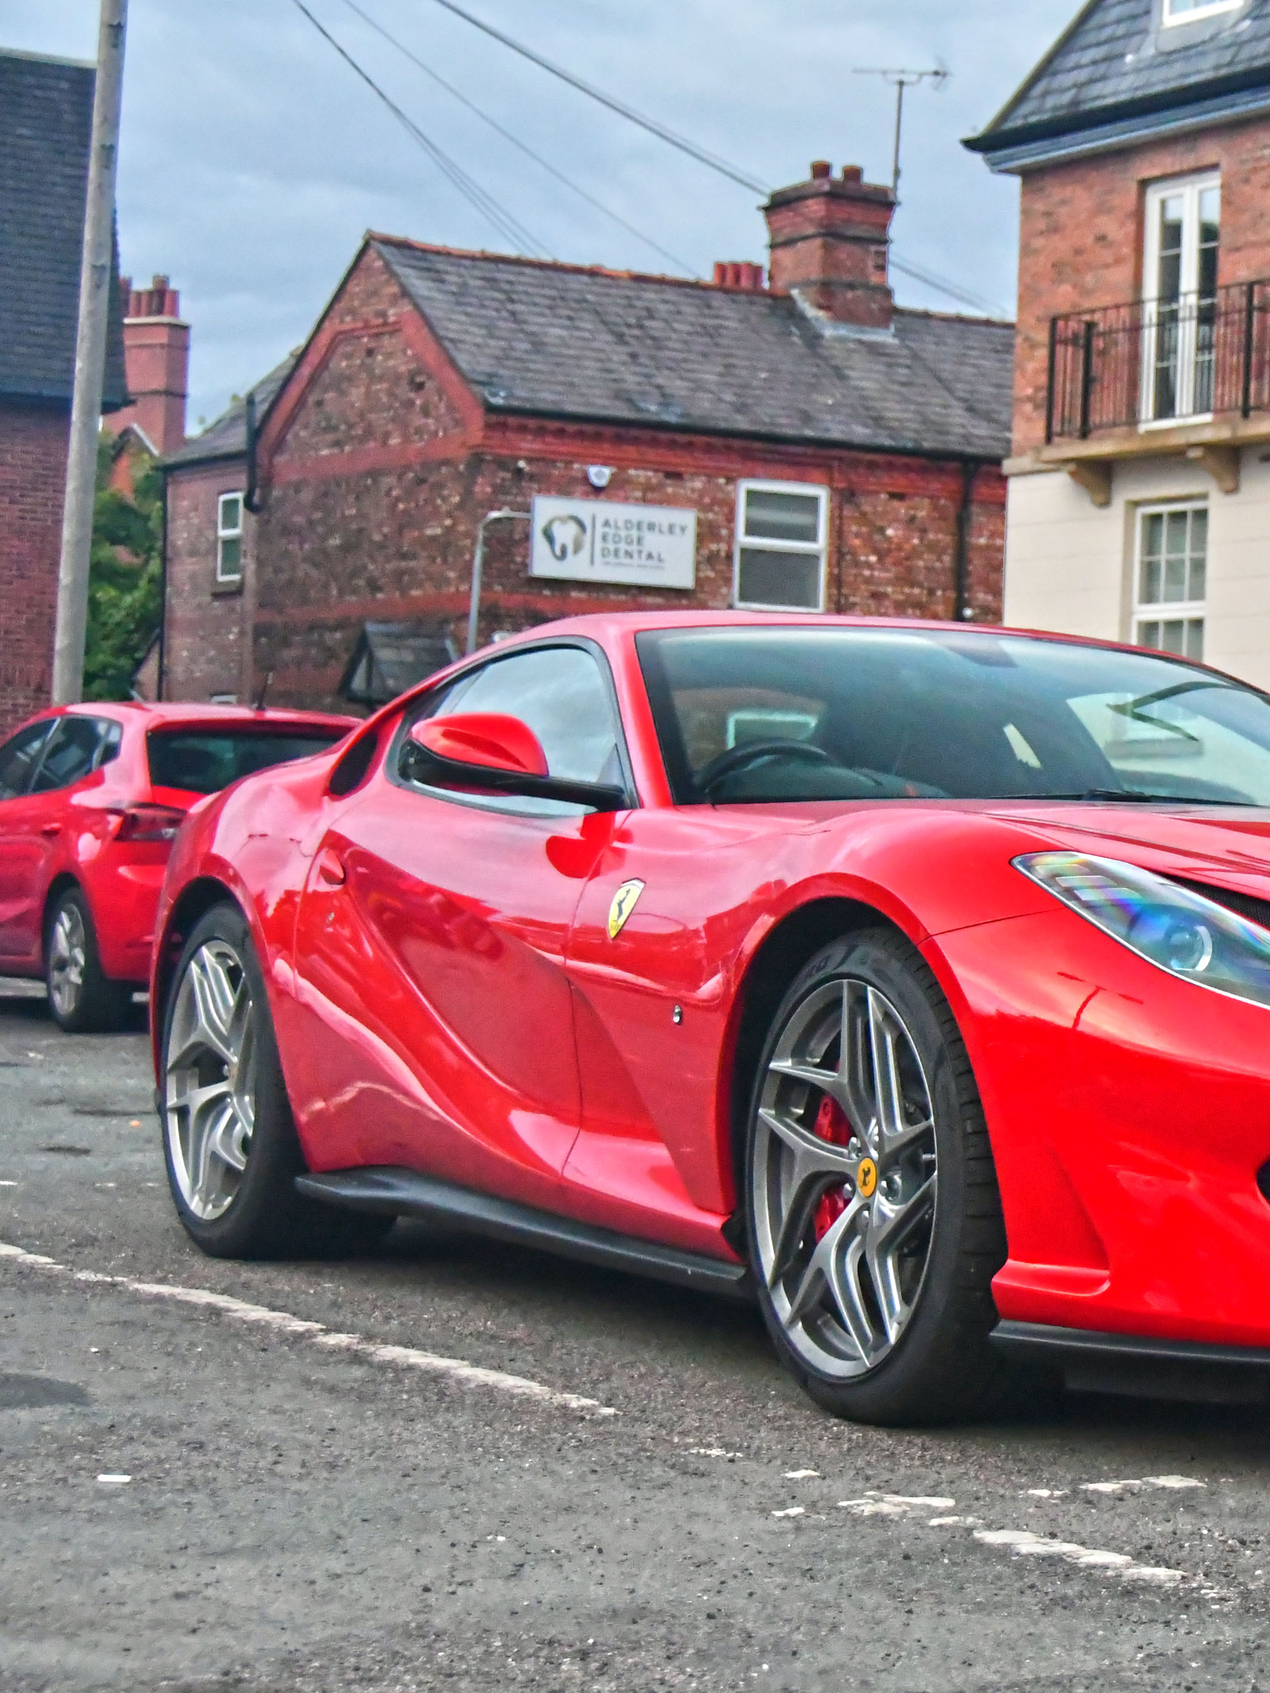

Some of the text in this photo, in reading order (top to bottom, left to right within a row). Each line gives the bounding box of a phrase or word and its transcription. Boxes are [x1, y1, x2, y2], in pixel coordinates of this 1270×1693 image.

[602, 518, 688, 536] ALDERLEY
[602, 531, 645, 547] EDGE
[601, 546, 666, 564] DENTAL
